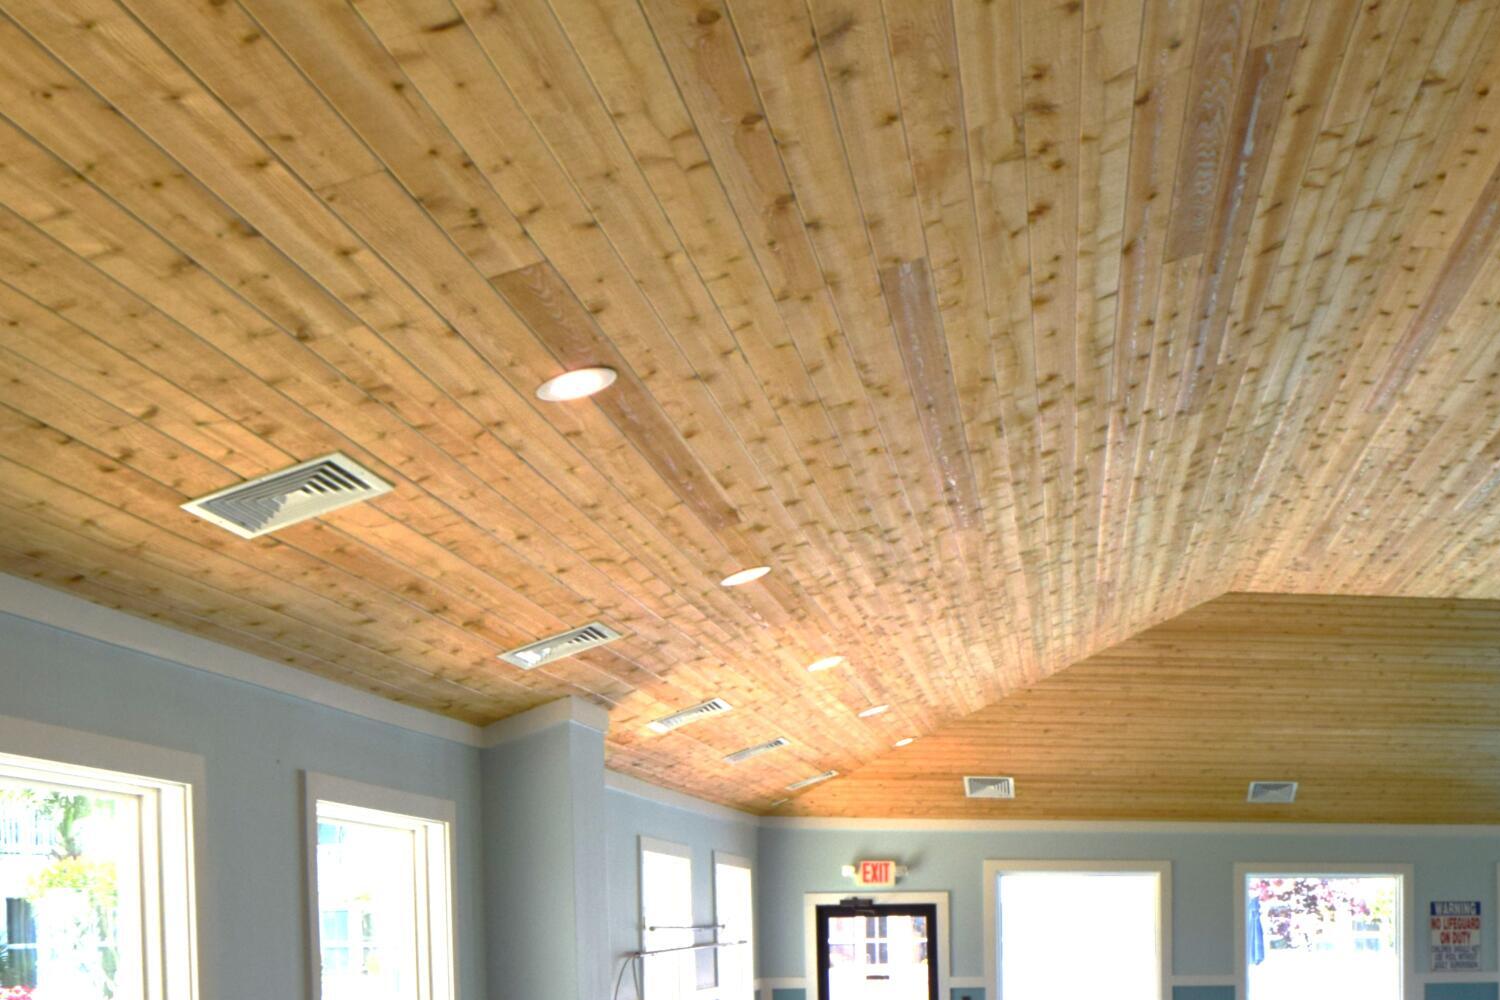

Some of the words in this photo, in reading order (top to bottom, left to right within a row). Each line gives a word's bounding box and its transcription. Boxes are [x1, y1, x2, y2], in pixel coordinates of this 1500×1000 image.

[863, 862, 890, 883] EXIT
[1435, 901, 1477, 916] WARNING
[1431, 917, 1441, 930] NO
[1443, 917, 1480, 930] LIFEGUARD
[1440, 931, 1450, 944] ON
[1452, 931, 1471, 944] DUTY
